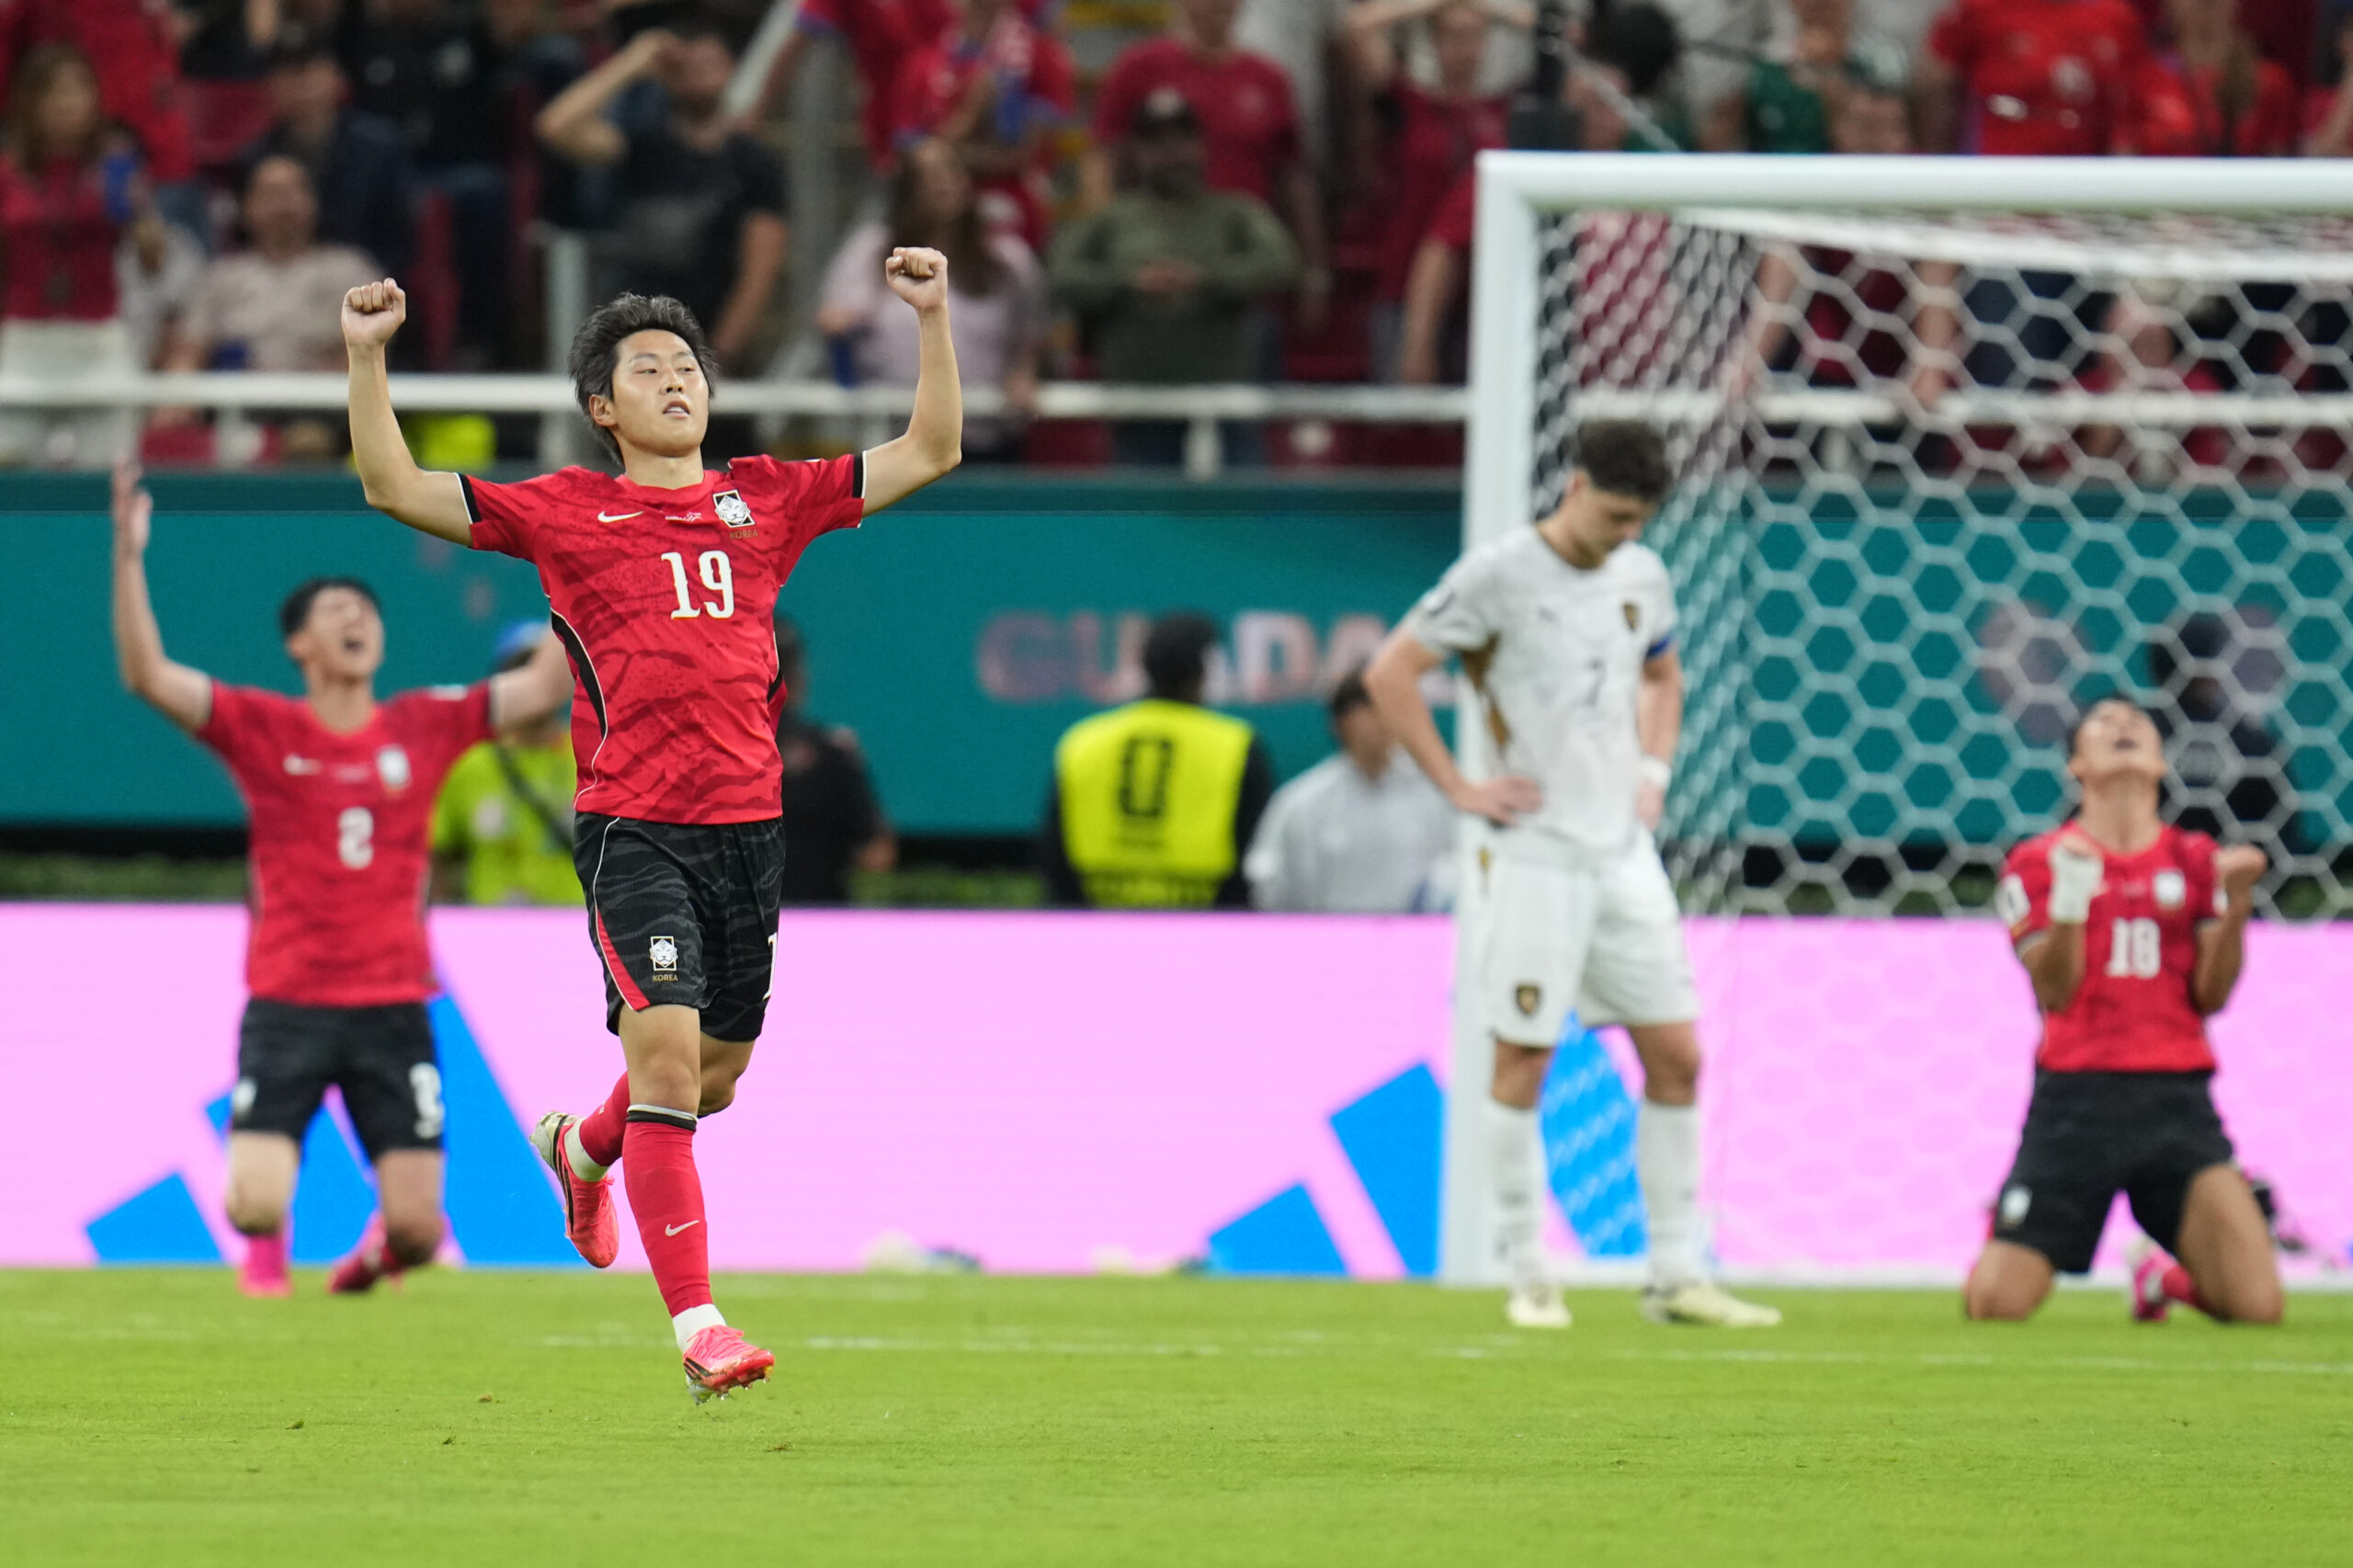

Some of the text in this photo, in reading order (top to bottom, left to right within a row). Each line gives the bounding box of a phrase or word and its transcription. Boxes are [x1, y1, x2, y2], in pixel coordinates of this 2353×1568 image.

[730, 528, 757, 540] KOREA
[661, 551, 733, 619] 19
[2106, 917, 2161, 979] 18
